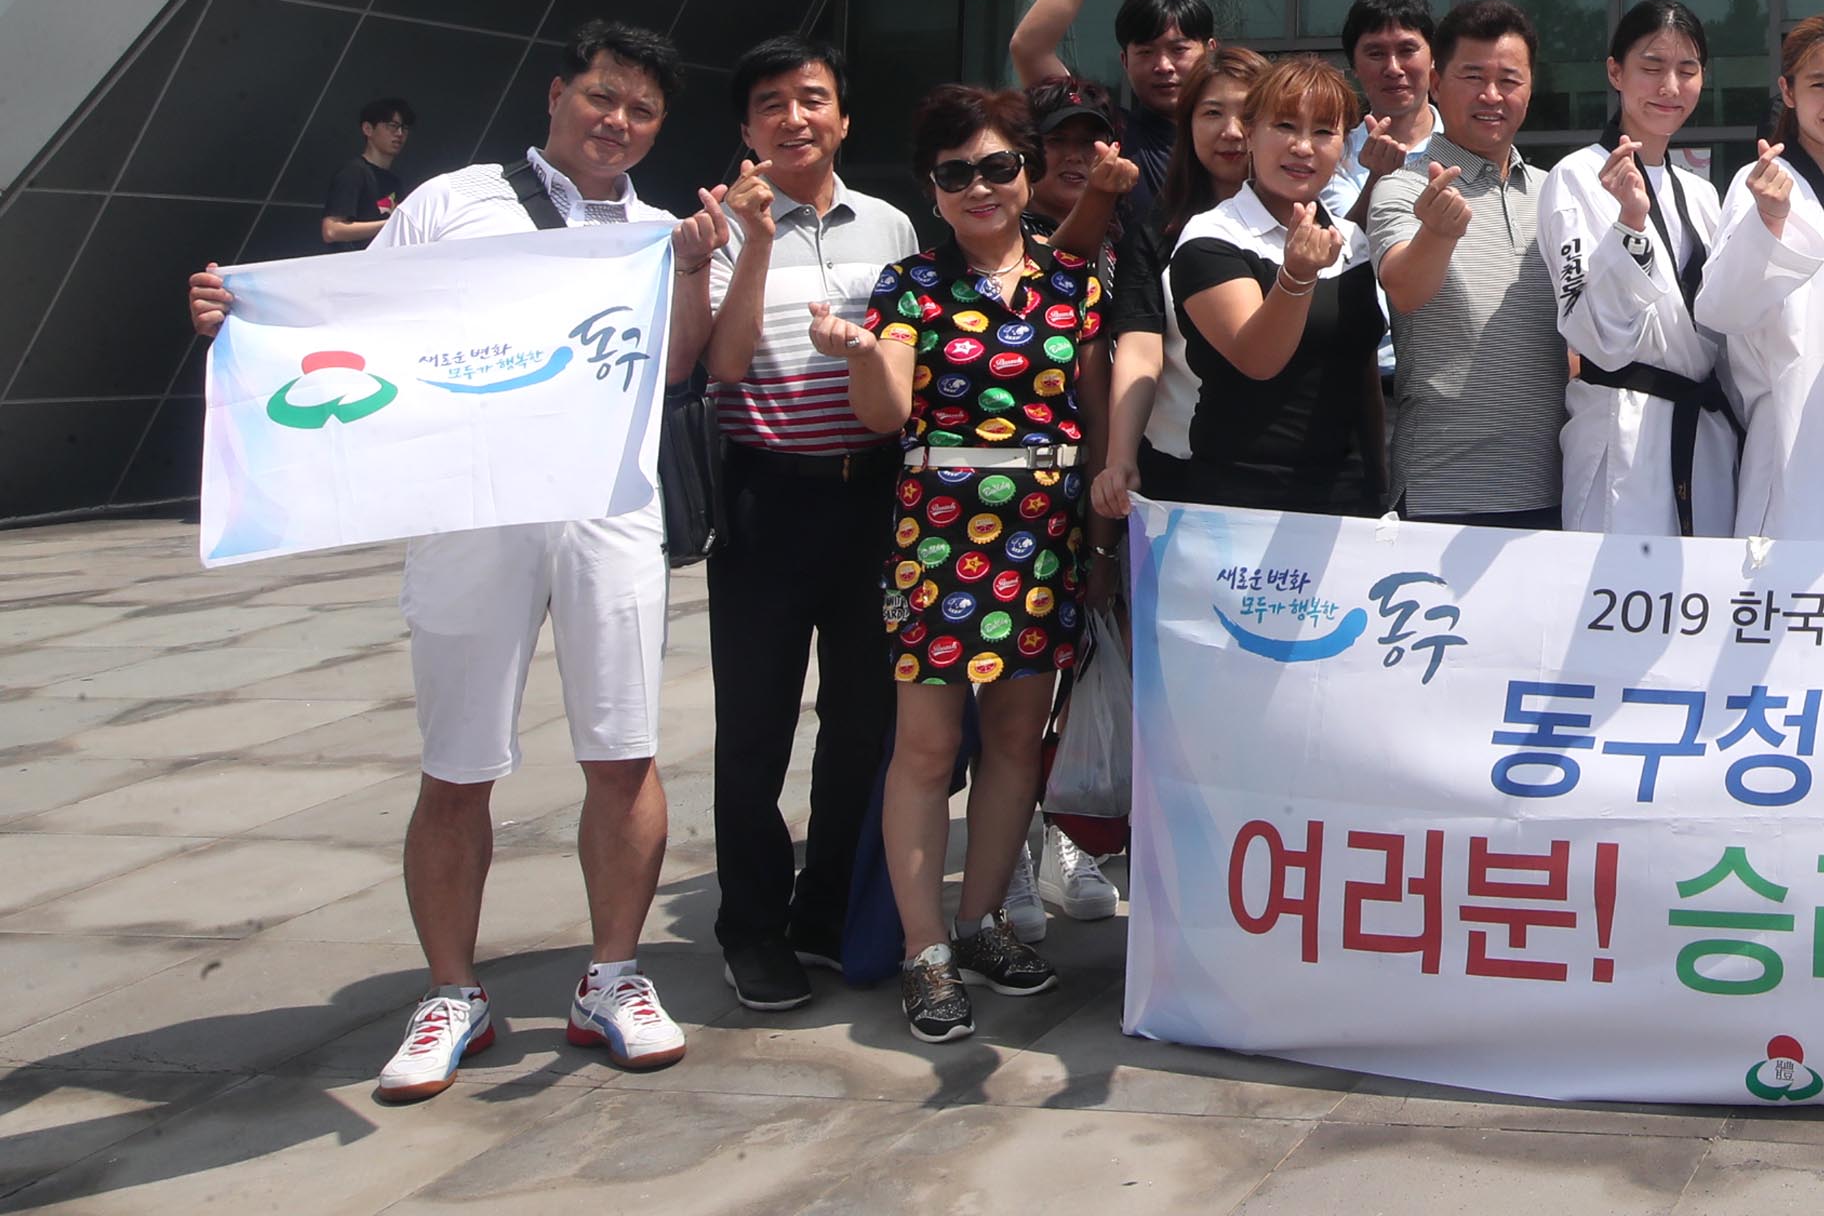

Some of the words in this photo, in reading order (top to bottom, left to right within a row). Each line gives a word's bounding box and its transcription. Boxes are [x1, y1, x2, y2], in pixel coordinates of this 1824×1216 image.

[418, 352, 467, 368] 새로운
[470, 344, 513, 360] 변화
[447, 363, 493, 380] 모두가
[496, 349, 545, 370] 행복한
[568, 305, 651, 393] 동구
[1217, 567, 1263, 591] 새로운
[1267, 569, 1311, 594] 변화
[1240, 597, 1285, 624] 모두가
[1289, 597, 1339, 628] 행복한
[1369, 572, 1468, 685] 동구
[1588, 588, 1709, 636] 2019
[1491, 680, 1822, 806] 동구청
[1228, 819, 1620, 984] 여러분!
